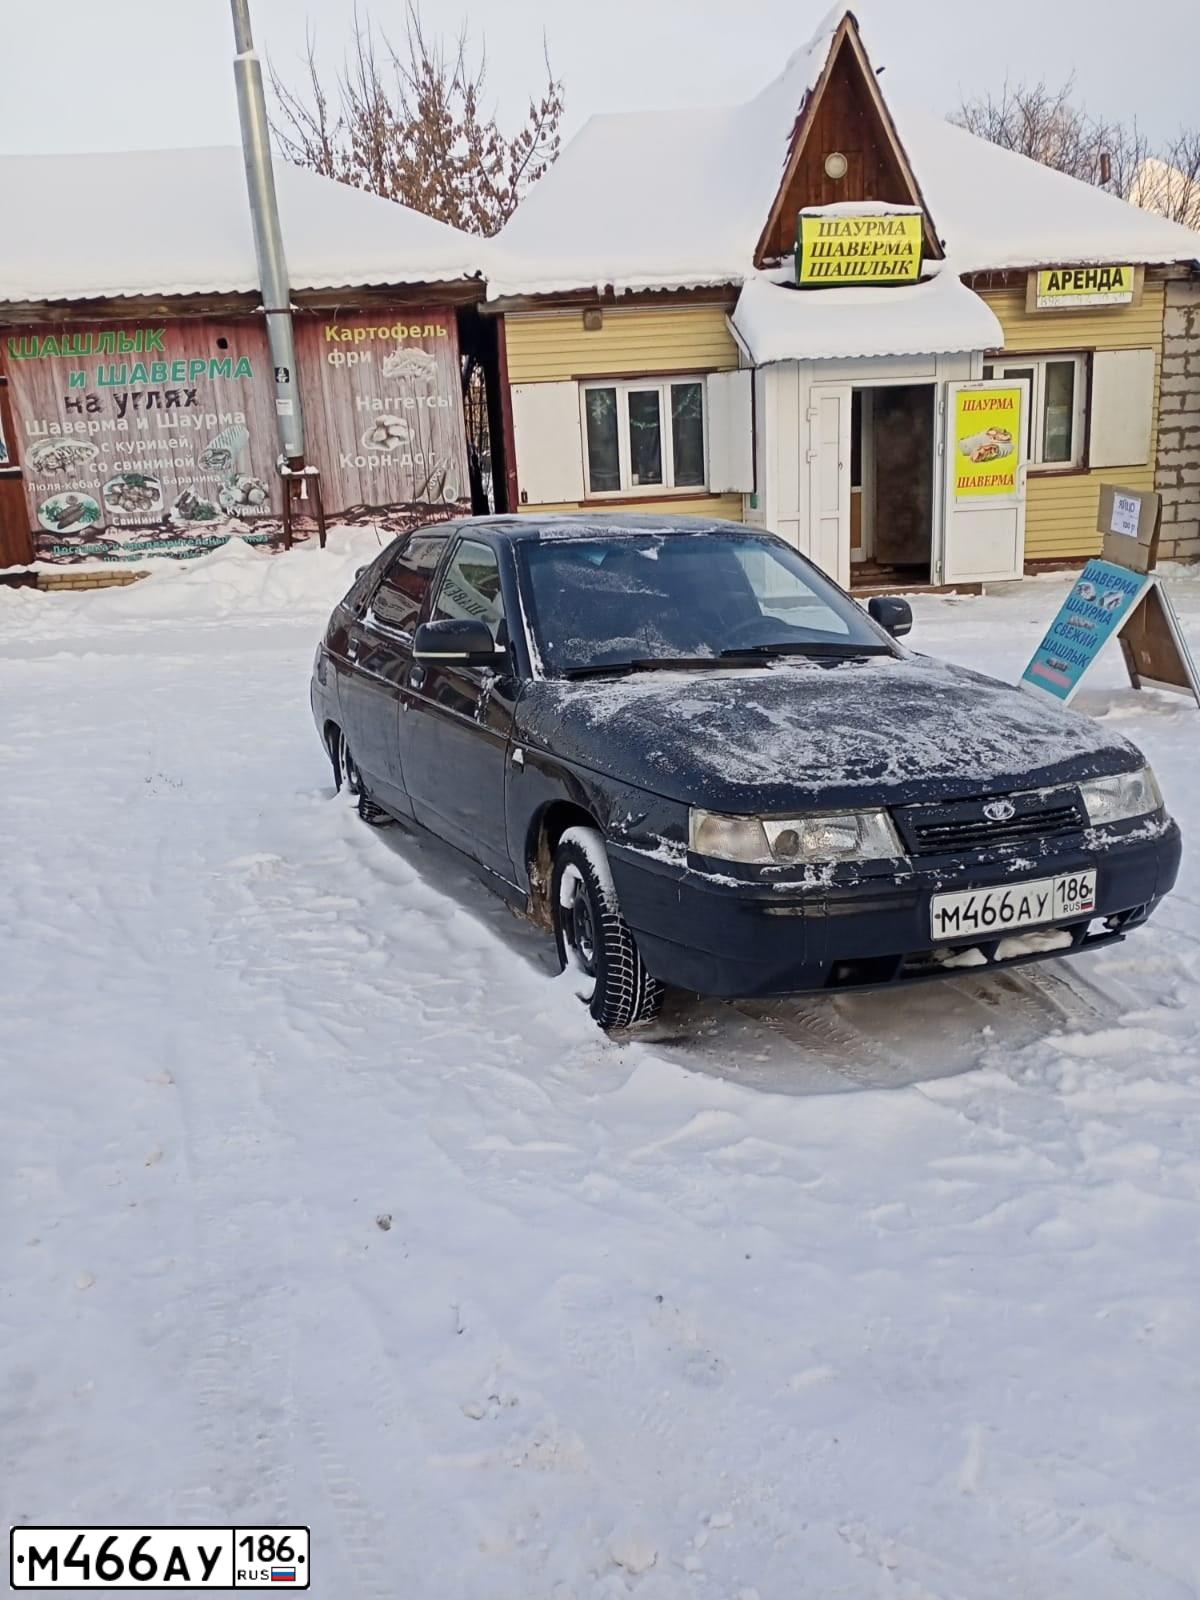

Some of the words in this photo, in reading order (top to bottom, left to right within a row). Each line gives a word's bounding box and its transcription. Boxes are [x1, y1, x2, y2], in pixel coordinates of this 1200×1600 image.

[818, 221, 906, 237] ШАУРМА
[810, 241, 913, 258] ШАВЕРМА
[808, 261, 912, 277] ШАШЛЫК
[1047, 268, 1124, 291] АРЕНДА
[325, 322, 449, 344] Картофель
[7, 328, 167, 361] ШАШЛЫК
[327, 349, 373, 367] фри
[69, 370, 87, 388] и
[97, 356, 254, 387] ШАВЕРМА
[64, 391, 103, 415] на
[113, 387, 200, 419] углях
[356, 395, 453, 412] Наггетсы
[962, 398, 1014, 412] ШАУРМА
[25, 418, 129, 437] Шаверма
[137, 417, 149, 430] и
[156, 410, 247, 431] Шаурма
[115, 437, 195, 455] курицей,
[89, 461, 109, 473] со
[113, 453, 195, 471] свининой
[28, 480, 101, 493] Люля-кебаб
[163, 475, 221, 487] Баранина
[957, 474, 1014, 488] ШАВЕРМА
[227, 505, 272, 517] Курица
[112, 515, 163, 527] Свинина
[1081, 567, 1139, 596] ШАВЕРМА
[1066, 598, 1114, 626] ШАУРМА
[1054, 622, 1099, 649] СВЕЖИЙ
[1041, 637, 1090, 669] ШАШЛЫК
[941, 891, 1049, 933] М466АУ
[1056, 875, 1090, 903] 186
[1063, 902, 1081, 913] RUS
